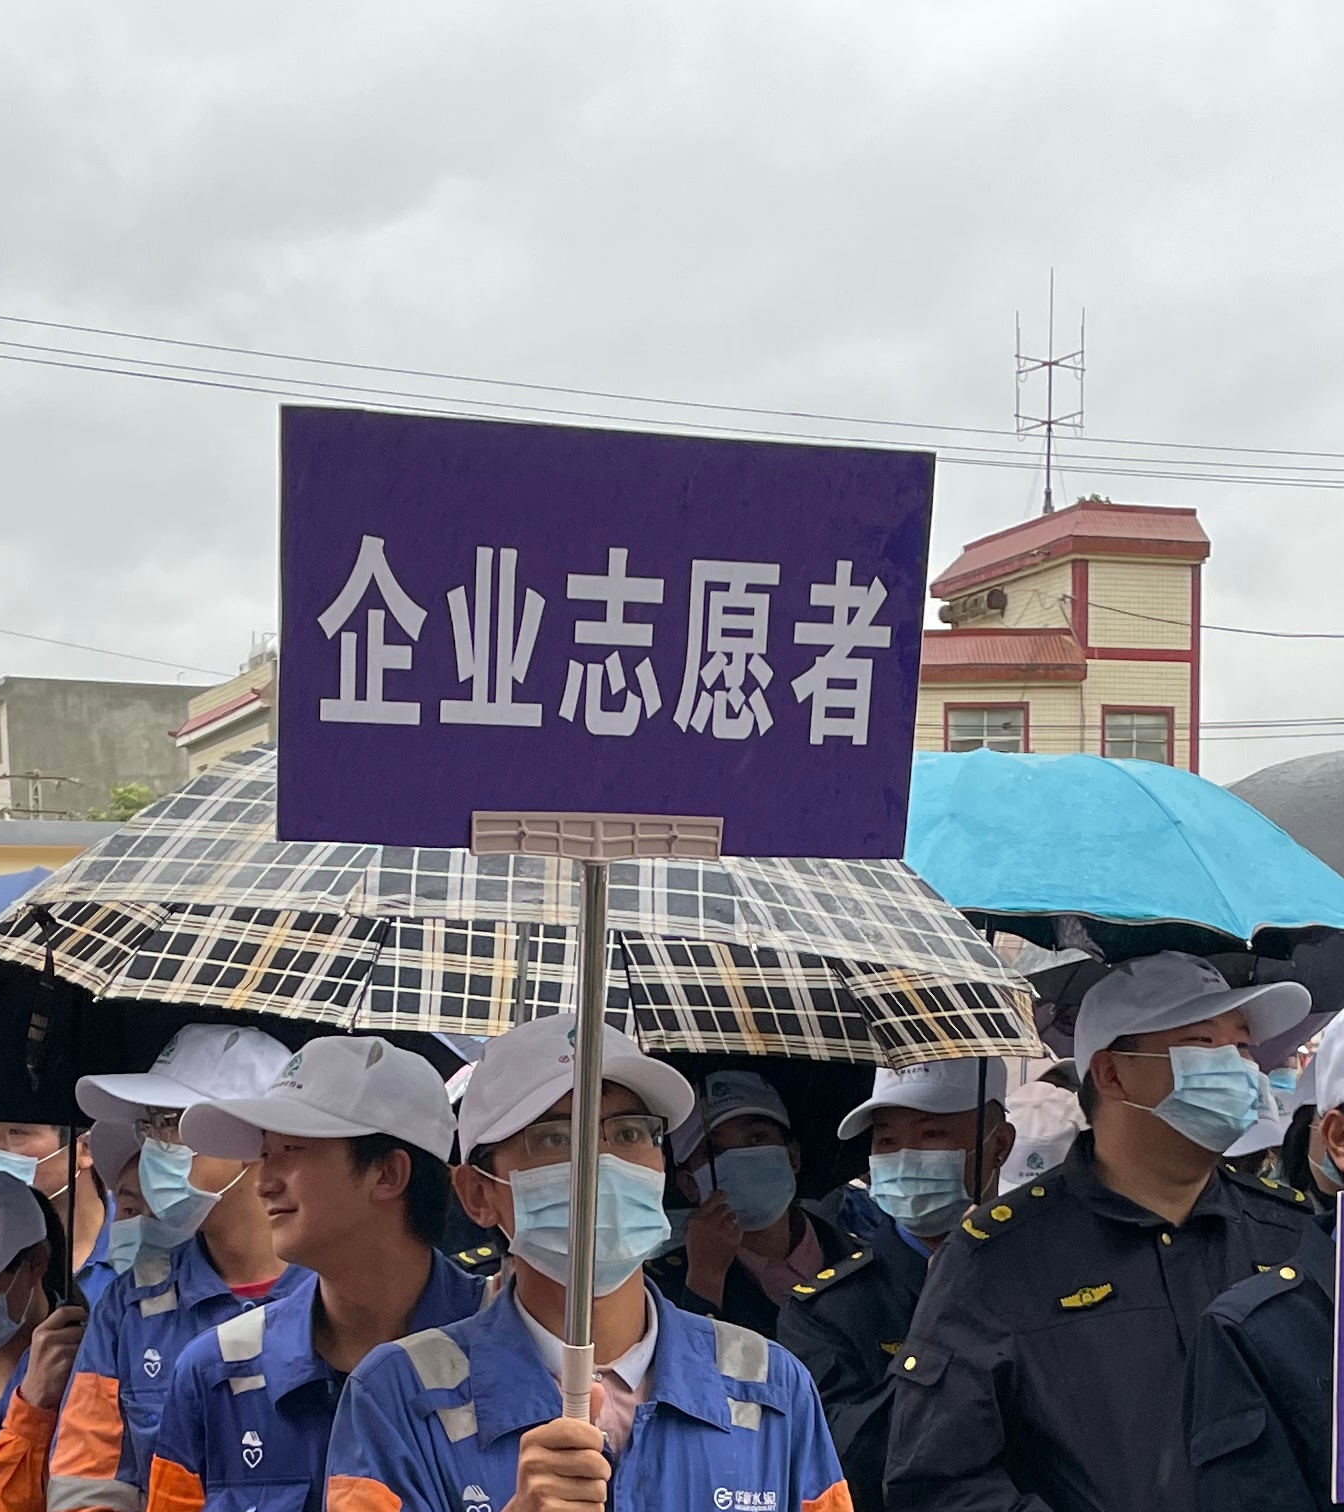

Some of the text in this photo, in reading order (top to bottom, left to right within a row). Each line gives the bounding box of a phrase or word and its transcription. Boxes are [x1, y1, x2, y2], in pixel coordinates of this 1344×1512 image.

[316, 534, 893, 746] 企业志愿者
